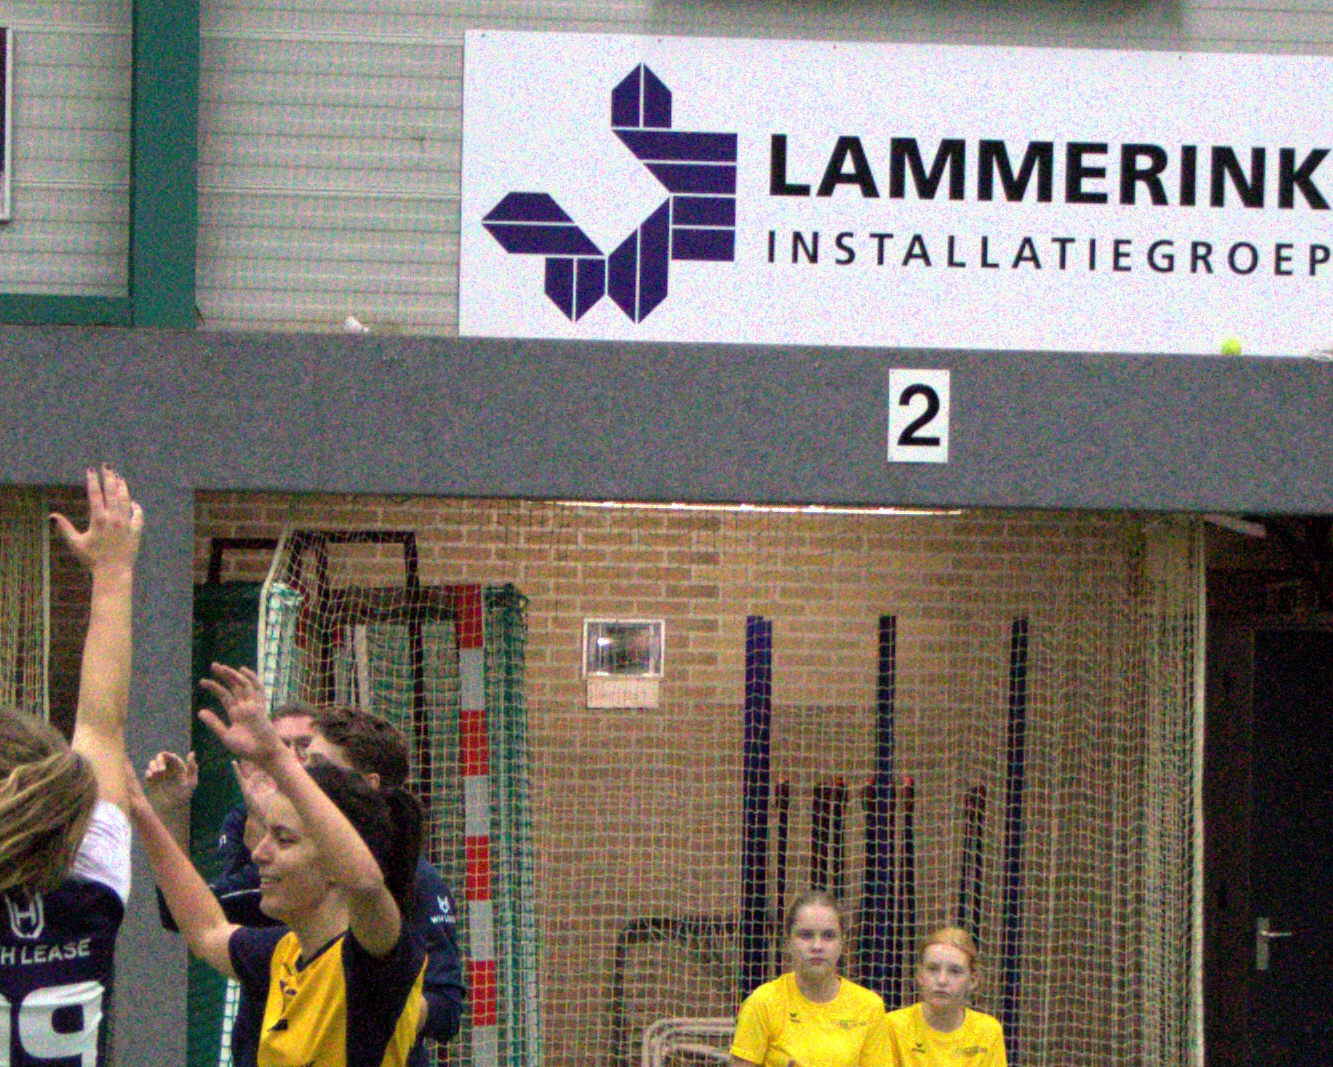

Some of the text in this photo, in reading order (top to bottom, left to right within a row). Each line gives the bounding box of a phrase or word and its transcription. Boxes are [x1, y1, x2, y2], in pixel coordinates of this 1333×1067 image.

[767, 133, 1332, 211] LAMMERINK
[766, 230, 1331, 276] INSTALLATIEGROEP
[895, 382, 942, 447] 2
[20, 938, 92, 965] LEASE
